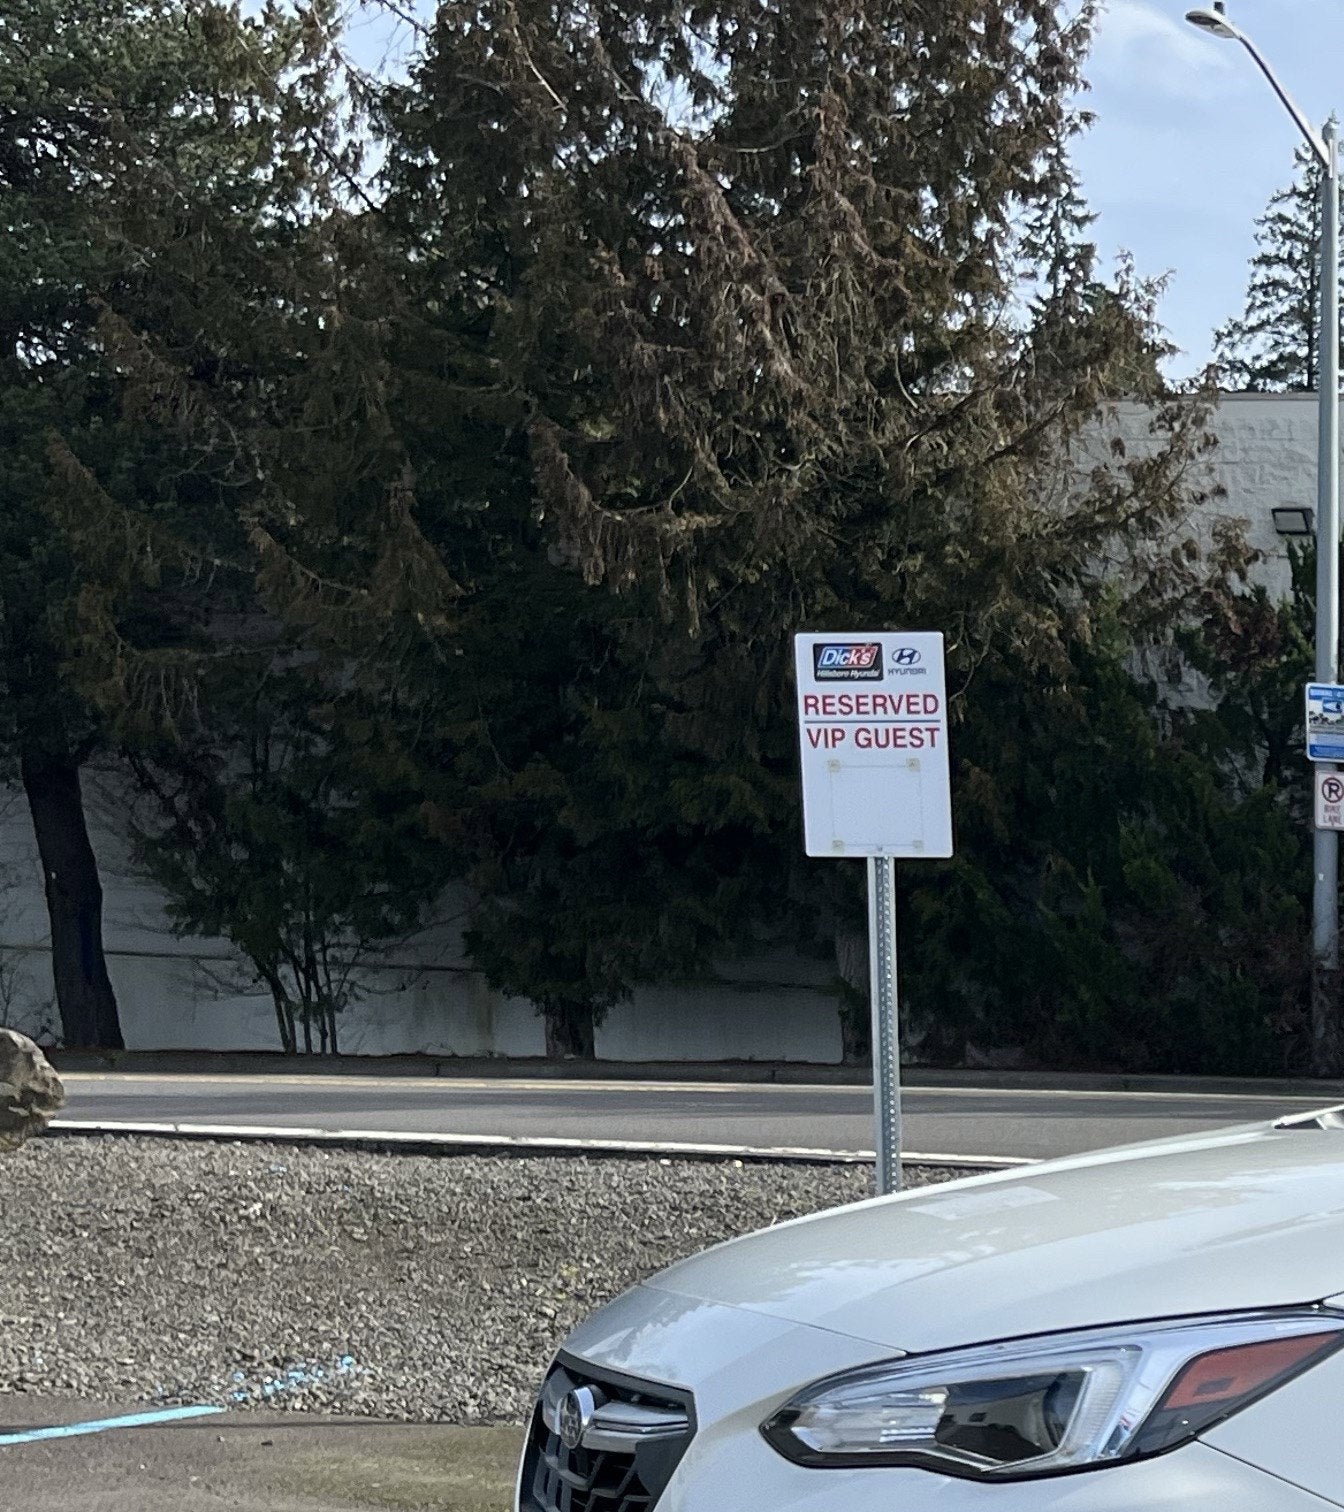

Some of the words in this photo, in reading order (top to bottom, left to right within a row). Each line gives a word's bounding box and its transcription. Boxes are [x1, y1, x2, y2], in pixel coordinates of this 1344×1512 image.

[804, 695, 939, 715] RESERVED
[807, 728, 846, 748] VIP
[855, 728, 940, 748] GUEST
